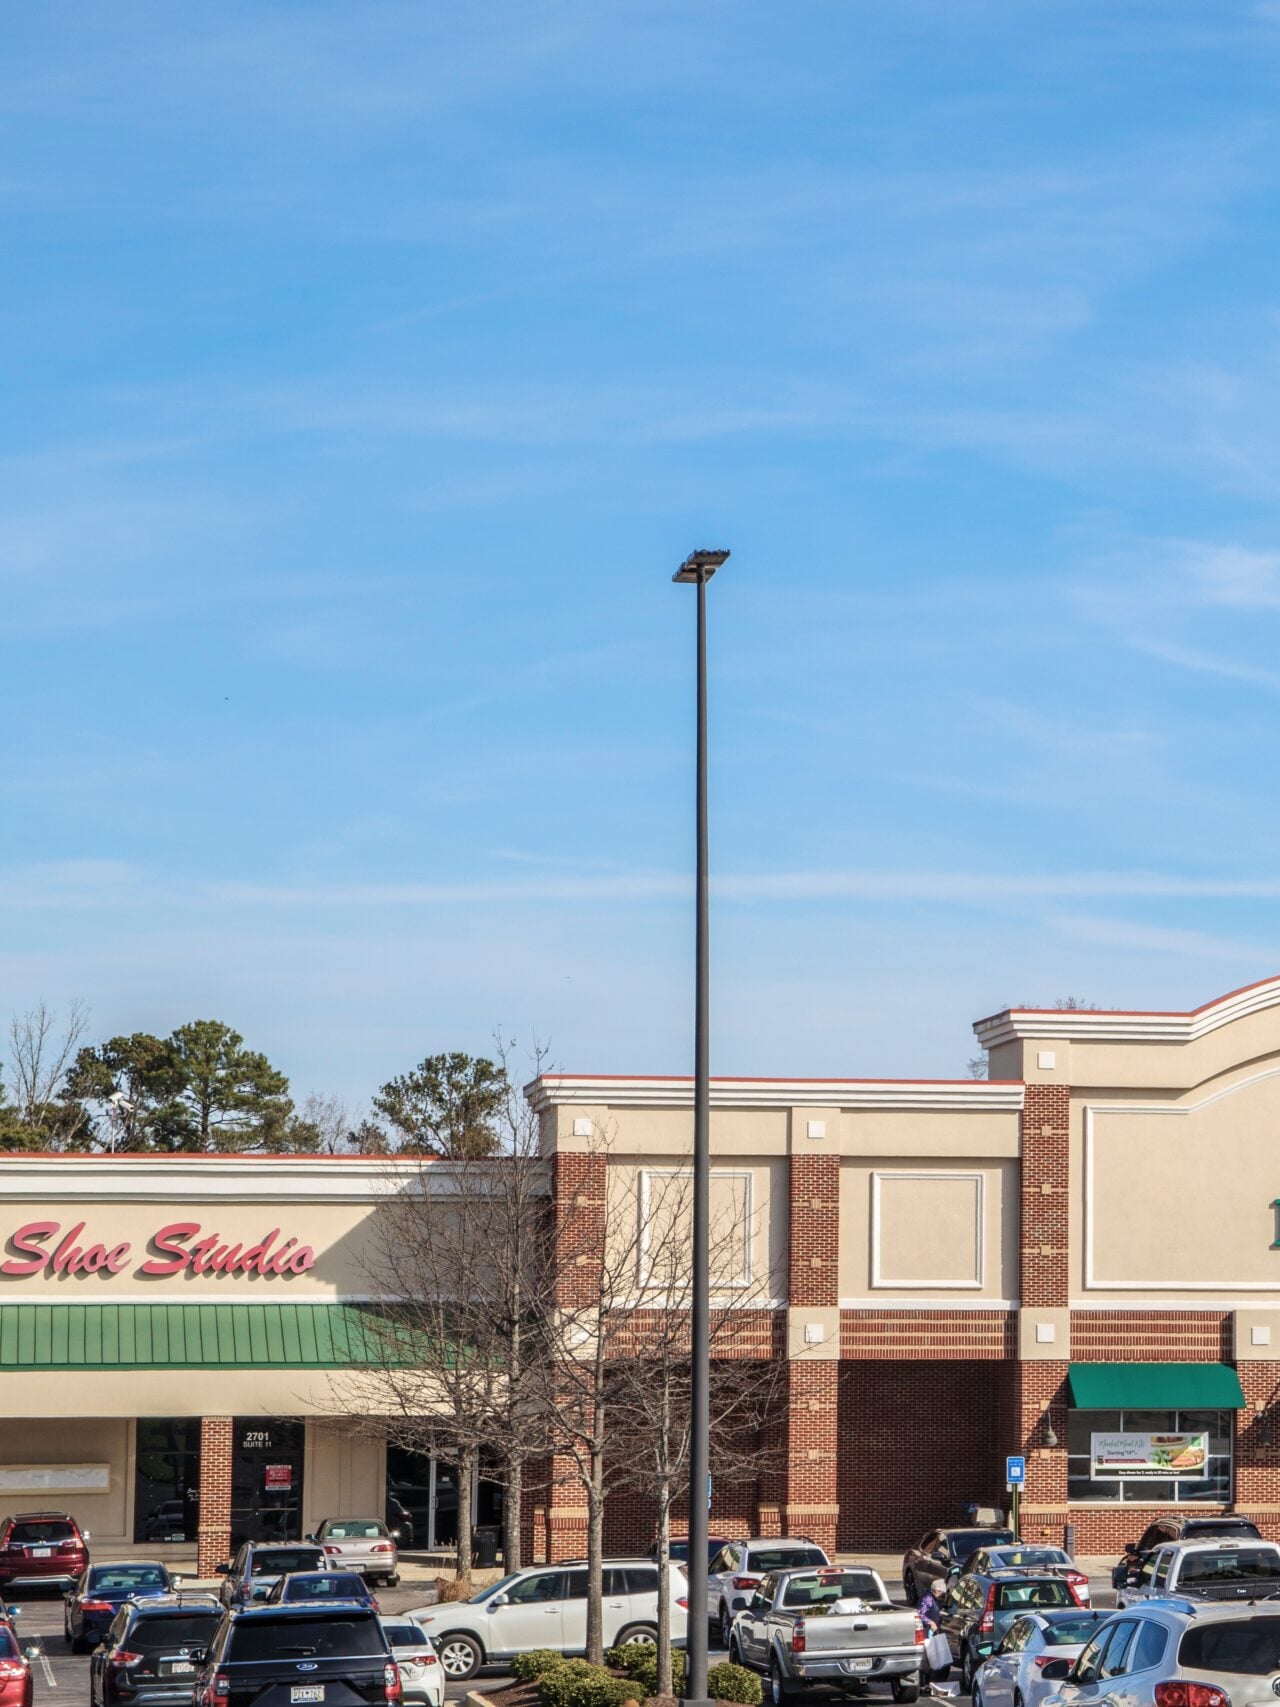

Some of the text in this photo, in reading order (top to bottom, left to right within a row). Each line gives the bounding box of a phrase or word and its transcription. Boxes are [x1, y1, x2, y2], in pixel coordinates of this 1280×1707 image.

[1, 1221, 315, 1275] Shoe Studio
[246, 1432, 269, 1441] 2701
